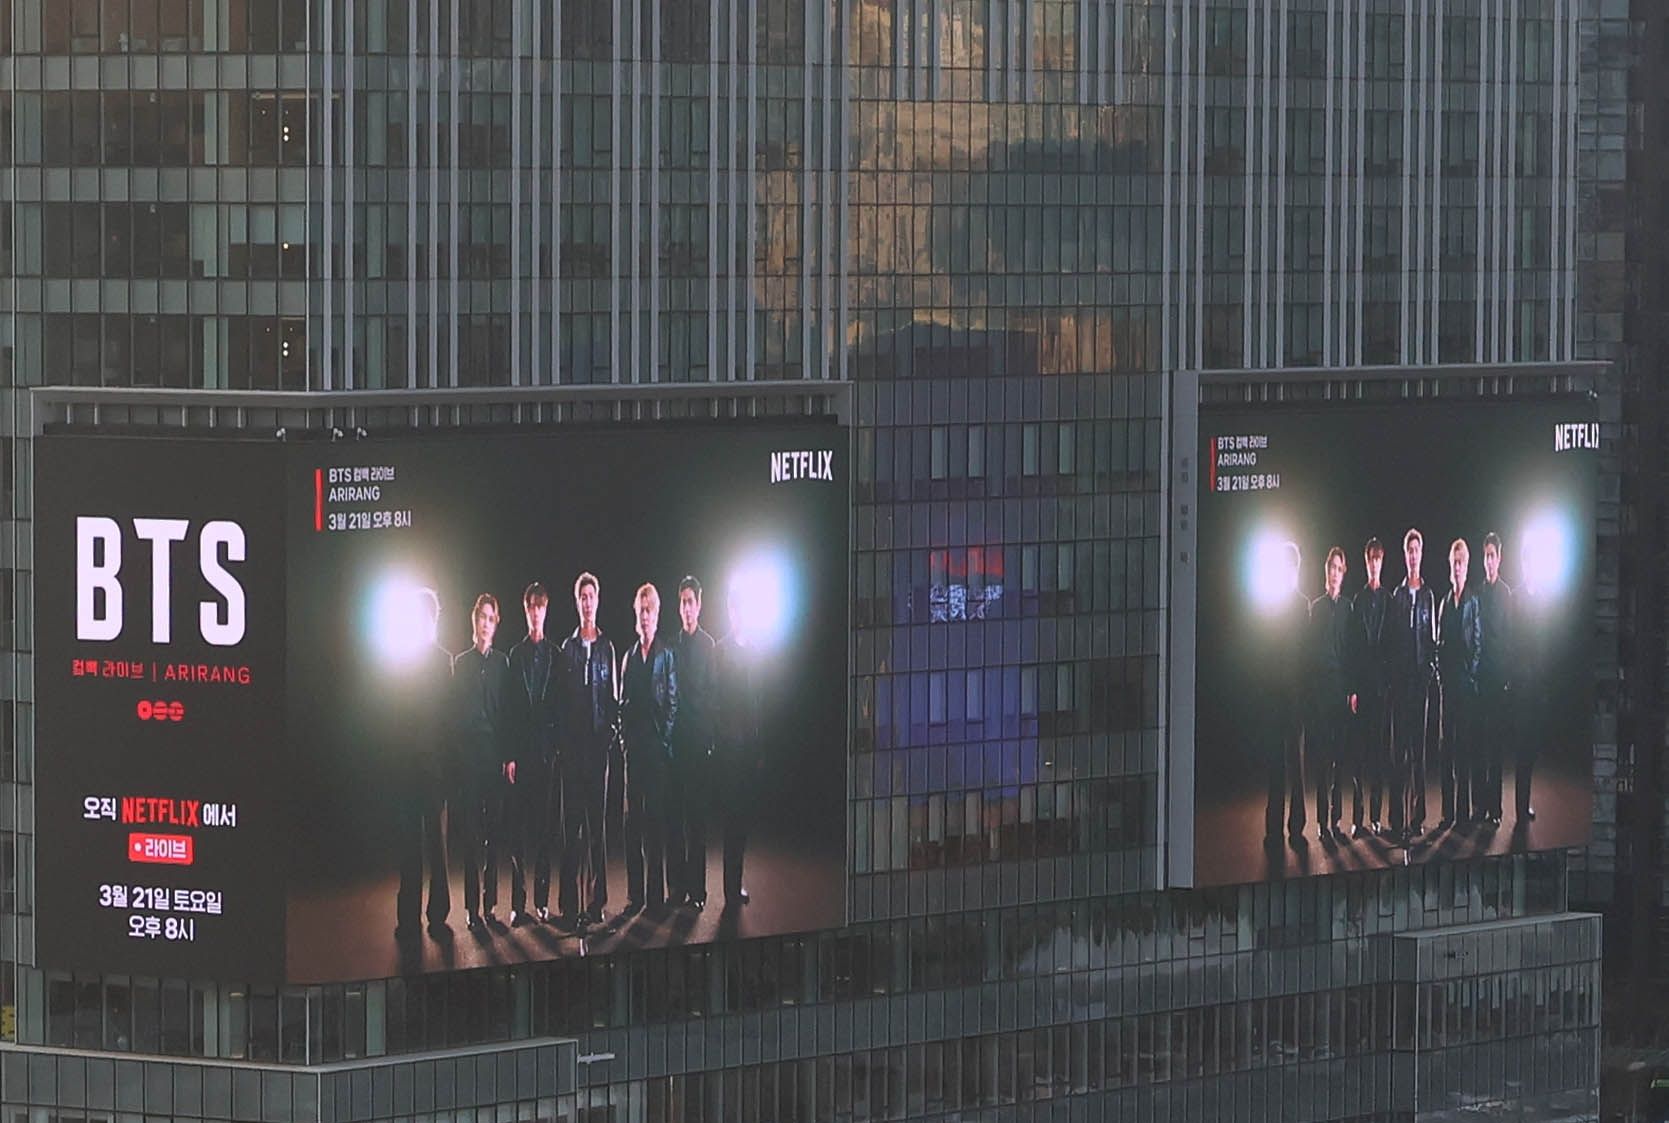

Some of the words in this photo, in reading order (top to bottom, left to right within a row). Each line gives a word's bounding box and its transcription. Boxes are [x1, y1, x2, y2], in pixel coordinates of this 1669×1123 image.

[1218, 436, 1235, 449] BTS
[771, 450, 833, 483] NETFLIX
[1217, 452, 1257, 467] ARIRANG
[329, 467, 352, 483] BTS
[371, 466, 395, 481] 라이브
[1217, 476, 1231, 491] 3월
[1232, 475, 1249, 491] 21일
[1250, 474, 1265, 489] 오후
[1266, 474, 1280, 489] 8시
[328, 486, 381, 502] ARIRANG
[328, 512, 346, 530] 3월
[348, 511, 371, 529] 21일
[373, 511, 392, 528] 오후
[394, 510, 412, 527] 8시
[76, 516, 247, 646] BTS
[72, 659, 98, 677] 컴백
[102, 660, 144, 679] 라이브
[164, 664, 251, 684] ARIRANG
[83, 796, 117, 821] 오직
[121, 796, 200, 828] NETFLIX
[203, 803, 236, 827] 에서
[145, 838, 187, 859] 라이브
[99, 884, 128, 908] 3월
[132, 886, 170, 911] 21일
[173, 889, 222, 915] 토요일
[128, 915, 161, 939] 오후
[164, 918, 194, 941] 8시
